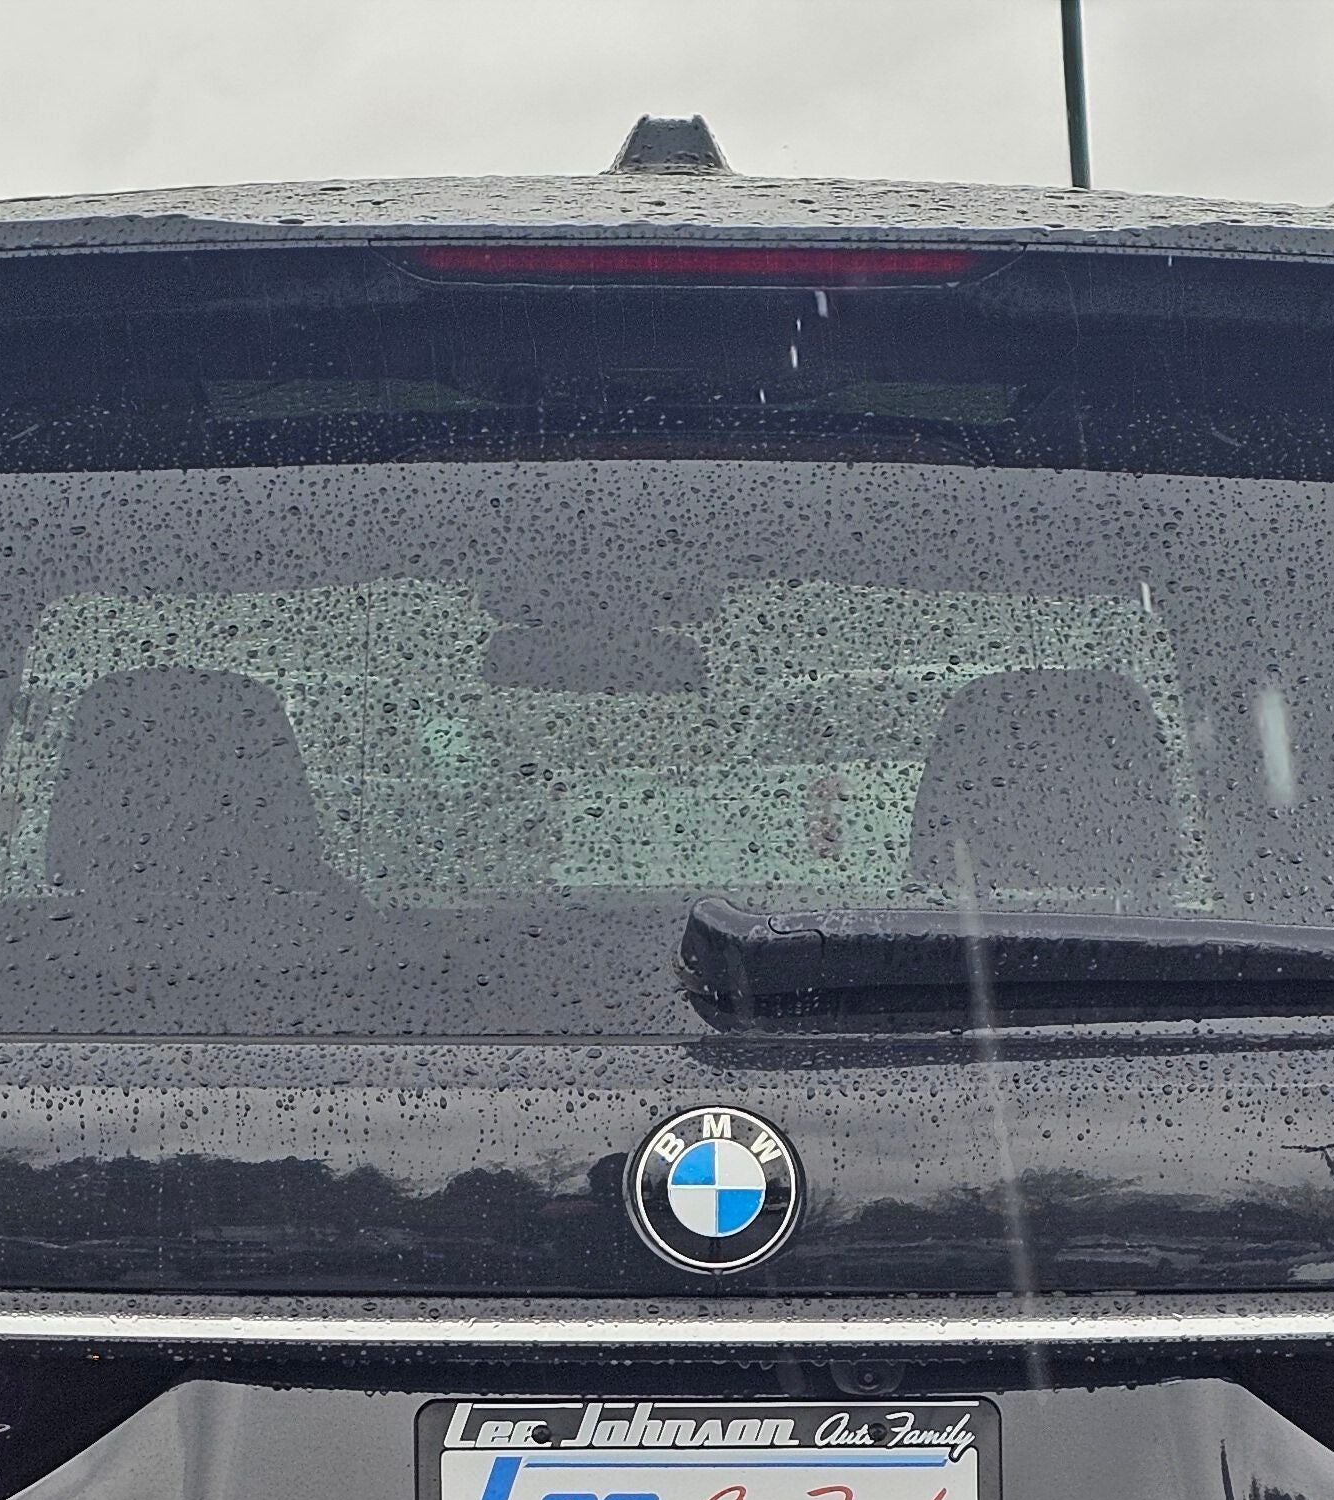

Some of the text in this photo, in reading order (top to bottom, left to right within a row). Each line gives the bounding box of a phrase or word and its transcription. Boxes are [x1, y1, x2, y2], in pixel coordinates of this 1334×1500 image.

[653, 1114, 783, 1164] BMW
[443, 1402, 975, 1459] Lee Johnson Aut Family
